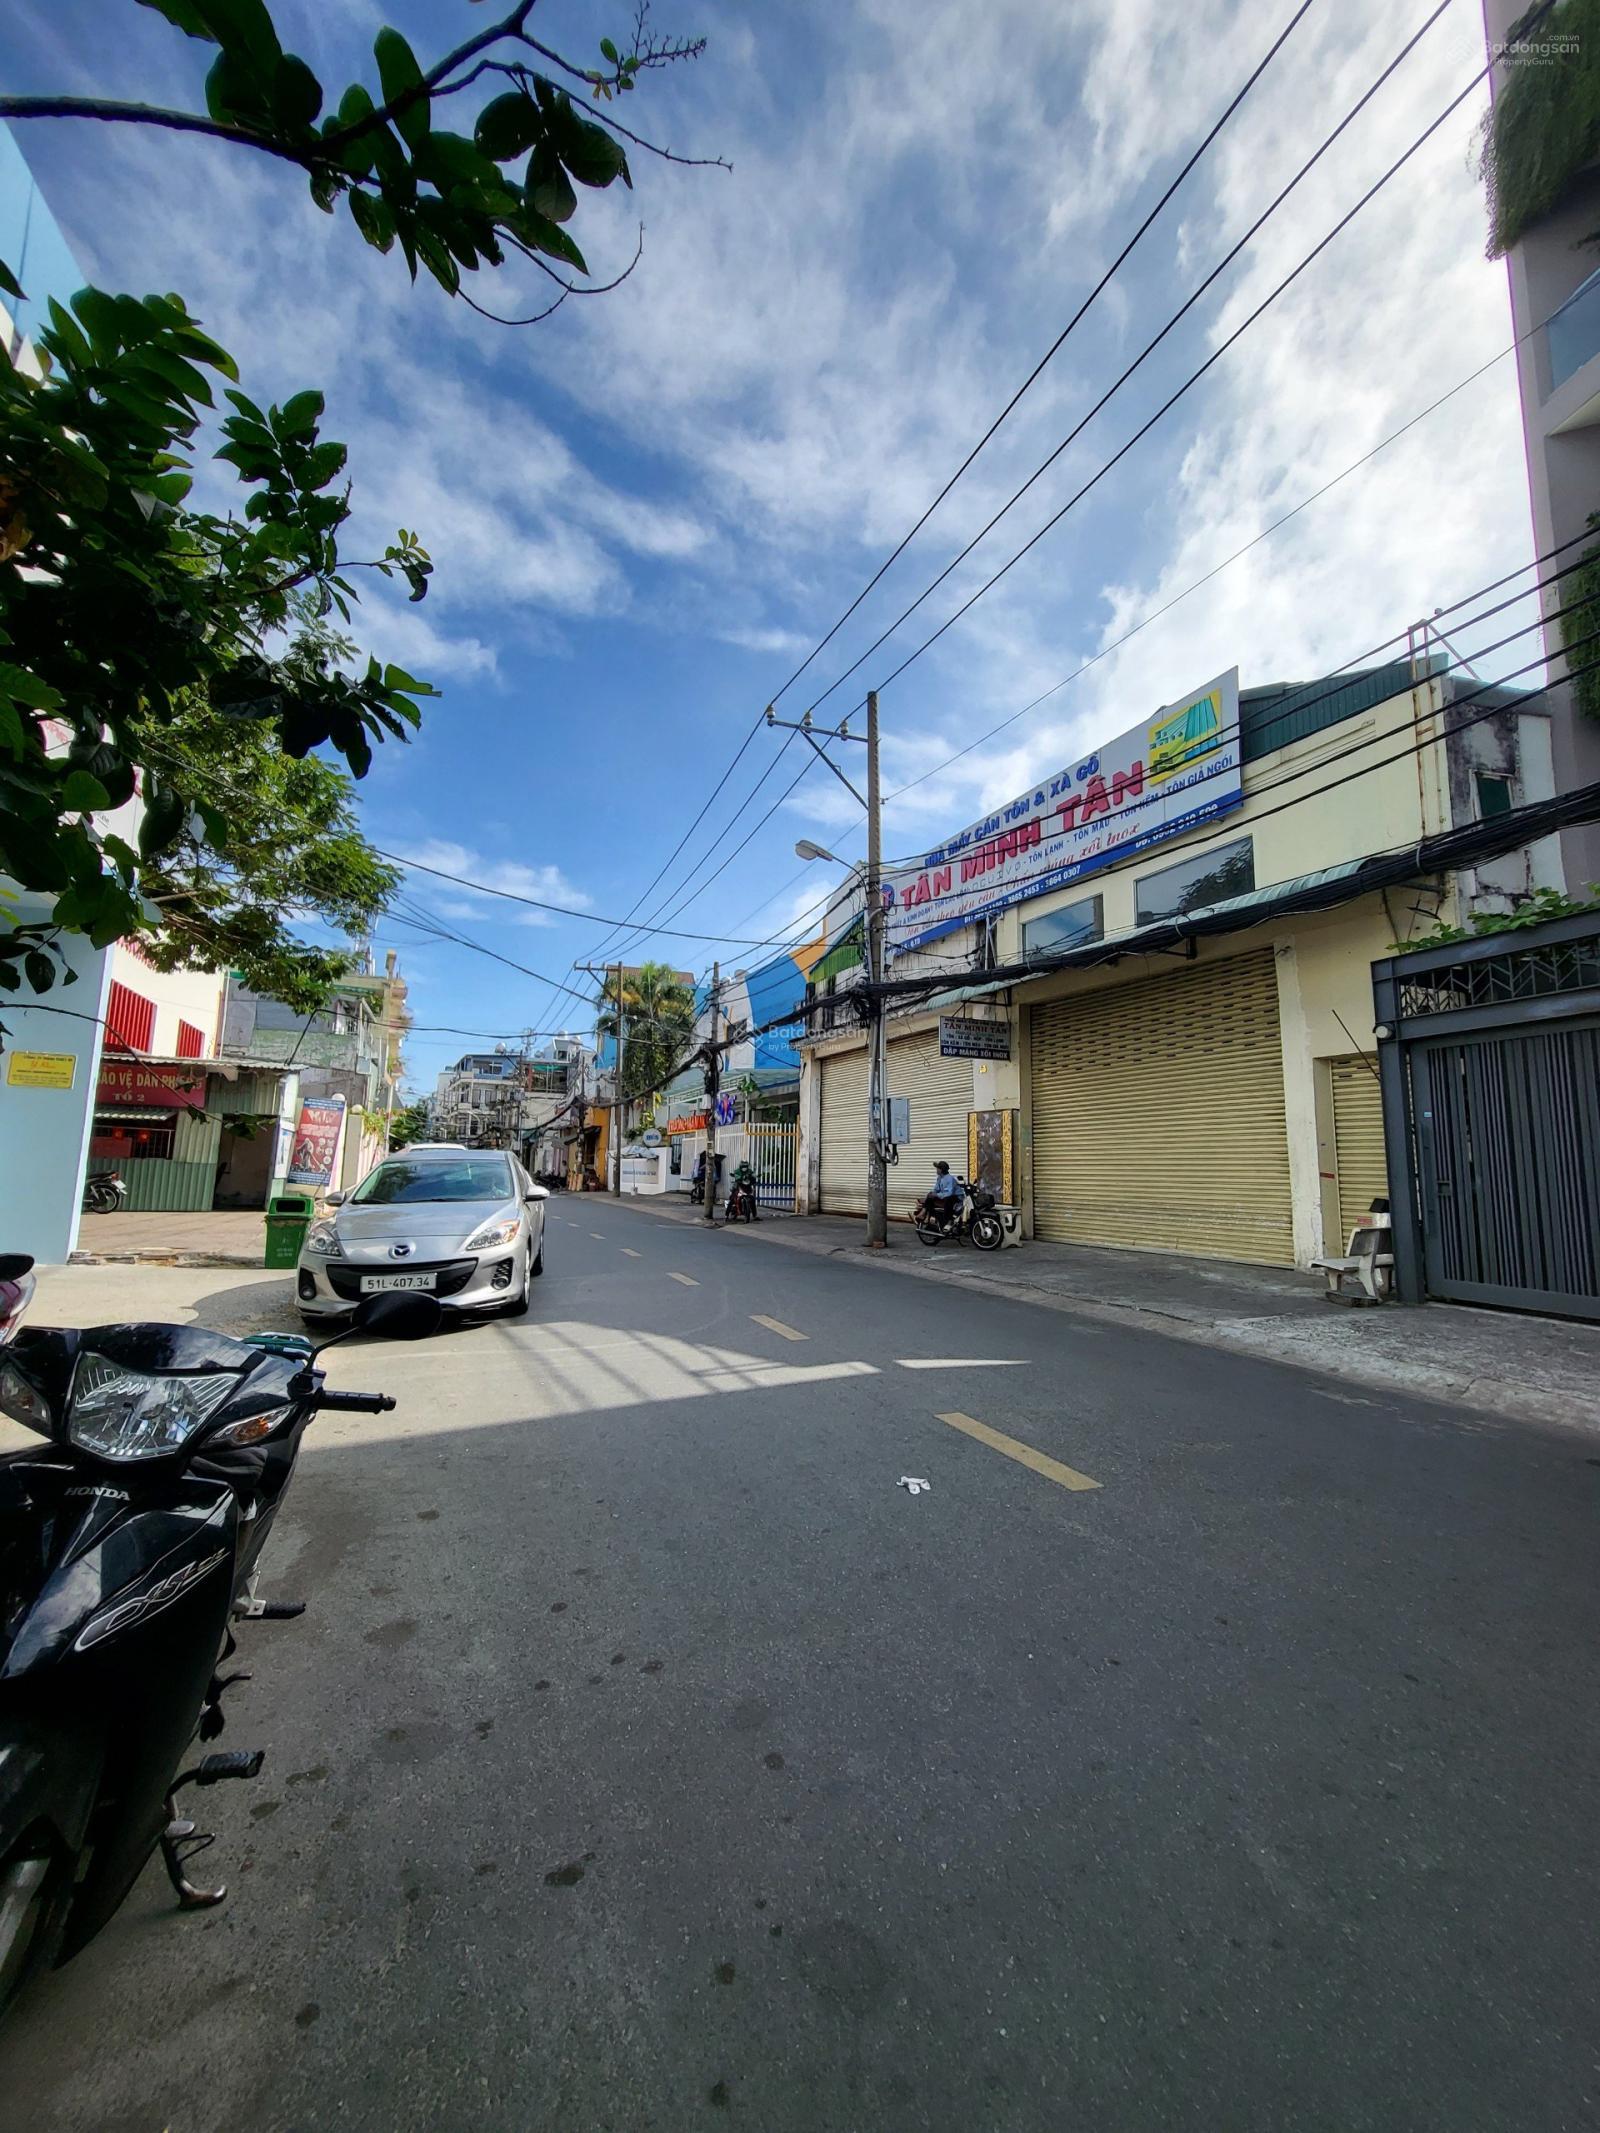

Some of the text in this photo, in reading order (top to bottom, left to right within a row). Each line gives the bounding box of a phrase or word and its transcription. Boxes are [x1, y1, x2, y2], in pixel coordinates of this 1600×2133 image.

[1003, 798, 1030, 824] TÔN
[1034, 791, 1046, 806] &
[1050, 772, 1071, 798] XÀ
[900, 865, 952, 912] TÂN
[960, 816, 1041, 883] MINH
[1056, 760, 1144, 832] TÂN
[119, 1070, 133, 1088] VỆ
[64, 1486, 130, 1501] HONDA
